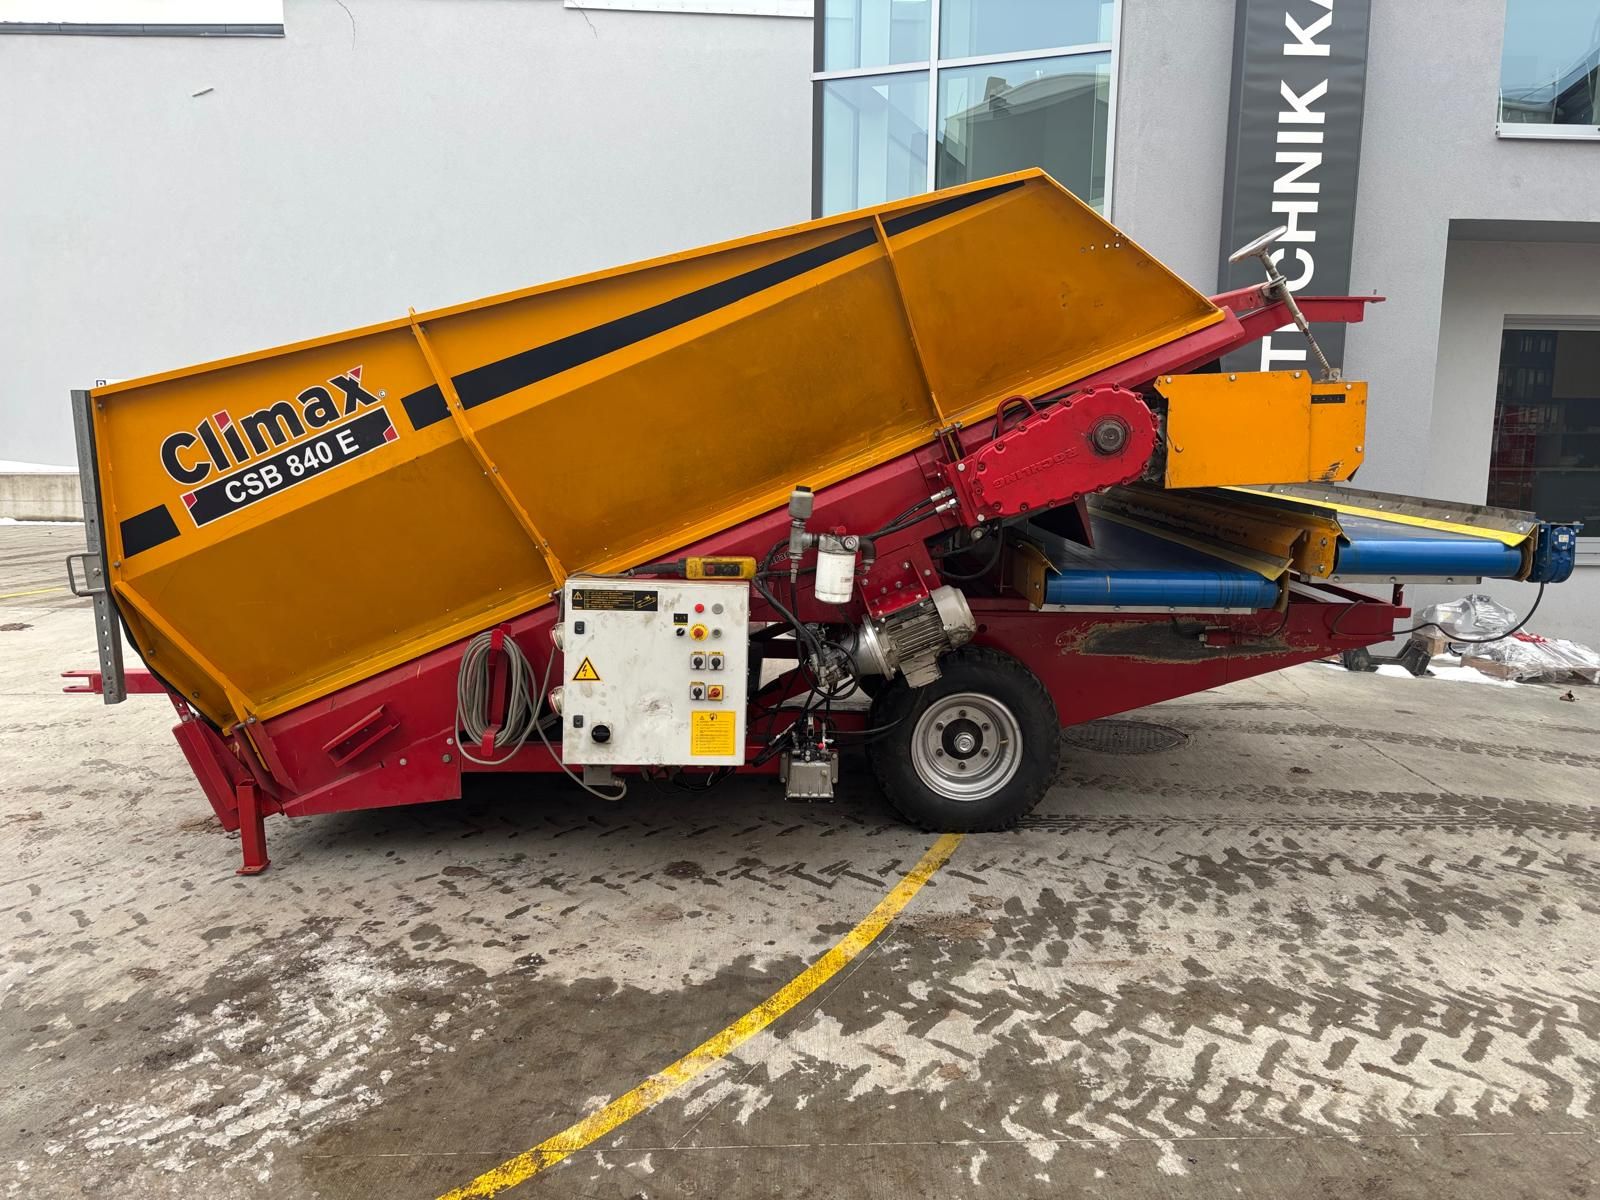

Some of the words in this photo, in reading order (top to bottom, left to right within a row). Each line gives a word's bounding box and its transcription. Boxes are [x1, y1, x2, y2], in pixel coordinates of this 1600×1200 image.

[1283, 0, 1334, 57] K
[1260, 78, 1329, 372] TCHNIK
[160, 365, 381, 485] Climax
[224, 465, 284, 503] CSB
[286, 441, 334, 477] 840
[335, 429, 360, 455] E
